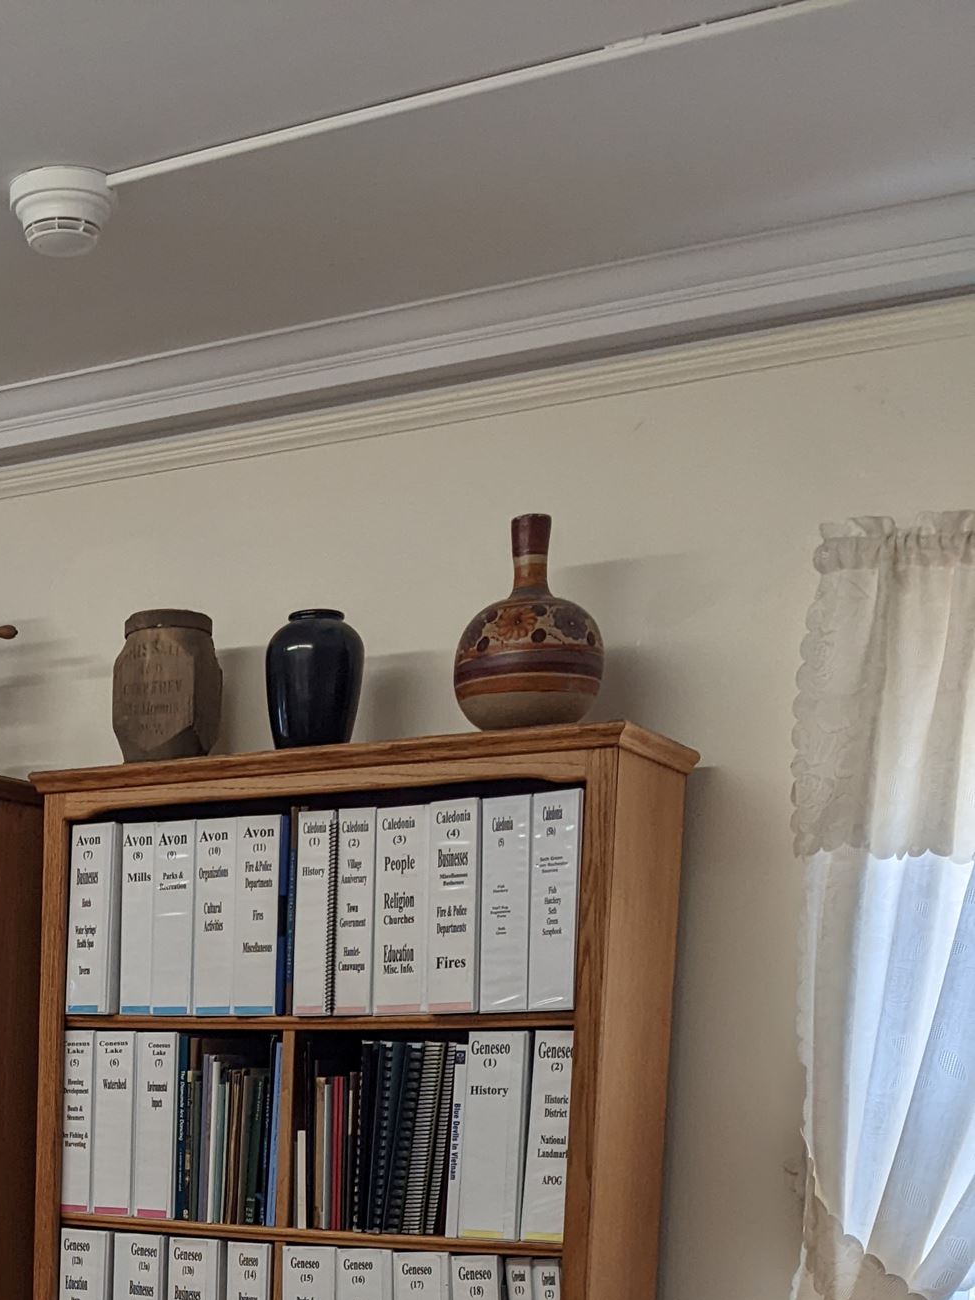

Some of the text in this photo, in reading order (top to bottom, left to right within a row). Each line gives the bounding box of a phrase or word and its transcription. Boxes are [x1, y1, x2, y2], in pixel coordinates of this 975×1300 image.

[436, 809, 470, 824] Caledonia
[303, 821, 326, 834] Caledonia
[342, 820, 369, 833] Caledonia
[382, 816, 415, 831] Caledonia
[200, 831, 228, 842] Avon
[244, 827, 274, 838] Avon
[447, 829, 460, 839] (4)
[76, 835, 100, 846] Avon
[124, 834, 152, 847] Avon
[159, 833, 187, 846] Avon
[309, 838, 320, 847] (1)
[348, 839, 360, 848] (2)
[393, 835, 406, 845] (3)
[83, 851, 93, 860] (7)
[133, 851, 143, 860] (8)
[208, 847, 221, 856] (10)
[347, 859, 362, 871] Village
[385, 855, 415, 874] People
[128, 872, 151, 882] Mills
[302, 867, 325, 877] History
[204, 902, 222, 914] Cultural
[347, 903, 358, 912] Town
[384, 892, 414, 913] Religion
[253, 910, 263, 920] Fires
[384, 914, 414, 925] Churches
[437, 923, 466, 937] Departments
[384, 944, 414, 963] Education
[436, 957, 466, 969] Fires
[471, 1040, 510, 1055] Geneseo
[110, 1058, 119, 1067] (6)
[155, 1059, 163, 1068] (7)
[483, 1058, 497, 1068] (1)
[551, 1063, 563, 1072] (2)
[103, 1079, 126, 1089] Watershed
[471, 1086, 508, 1097] History
[545, 1108, 567, 1117] District
[452, 1121, 460, 1141] Devils
[541, 1135, 566, 1144] National
[450, 1152, 458, 1180] Vietnam
[64, 1238, 90, 1251] Geneseo
[131, 1243, 157, 1257] Geneseo
[174, 1247, 202, 1261] Geneseo
[239, 1253, 258, 1267] Geneseo
[291, 1257, 319, 1269] Geneseo
[344, 1259, 373, 1270] Geneseo
[402, 1263, 432, 1275] Geneseo
[458, 1267, 491, 1280] Geneseo
[244, 1270, 256, 1280] (14)
[300, 1274, 313, 1283] (15)
[352, 1276, 365, 1284] (16)
[65, 1275, 87, 1290] Education
[410, 1281, 424, 1290] (17)
[129, 1280, 154, 1297] Businesses
[174, 1285, 201, 1300] Businesses
[470, 1286, 484, 1297] (18)
